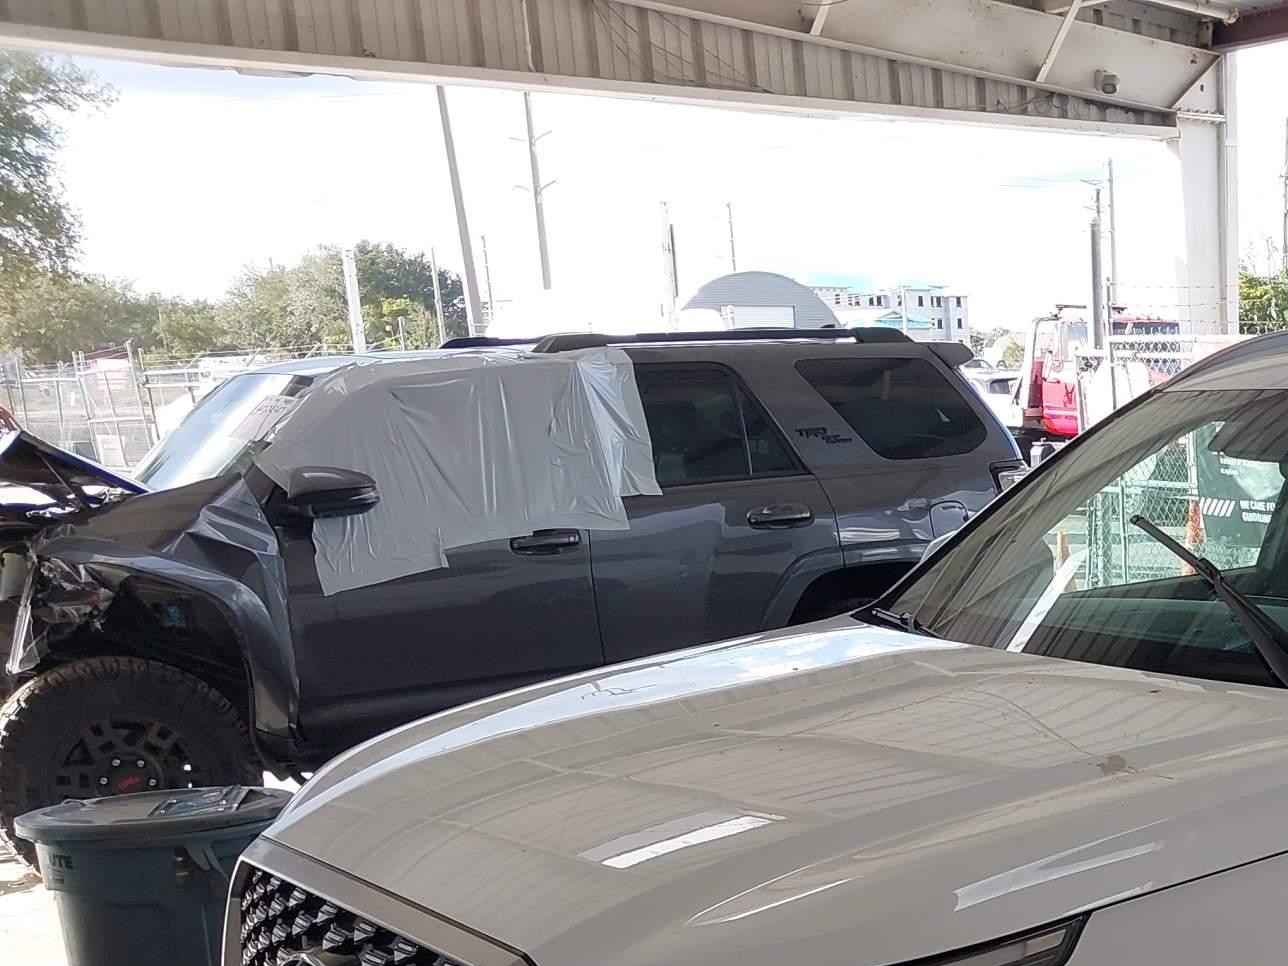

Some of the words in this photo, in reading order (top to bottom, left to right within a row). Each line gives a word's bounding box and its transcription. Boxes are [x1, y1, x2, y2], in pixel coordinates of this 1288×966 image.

[1250, 500, 1266, 511] CARE
[1266, 502, 1276, 511] FO
[50, 854, 74, 869] UTE
